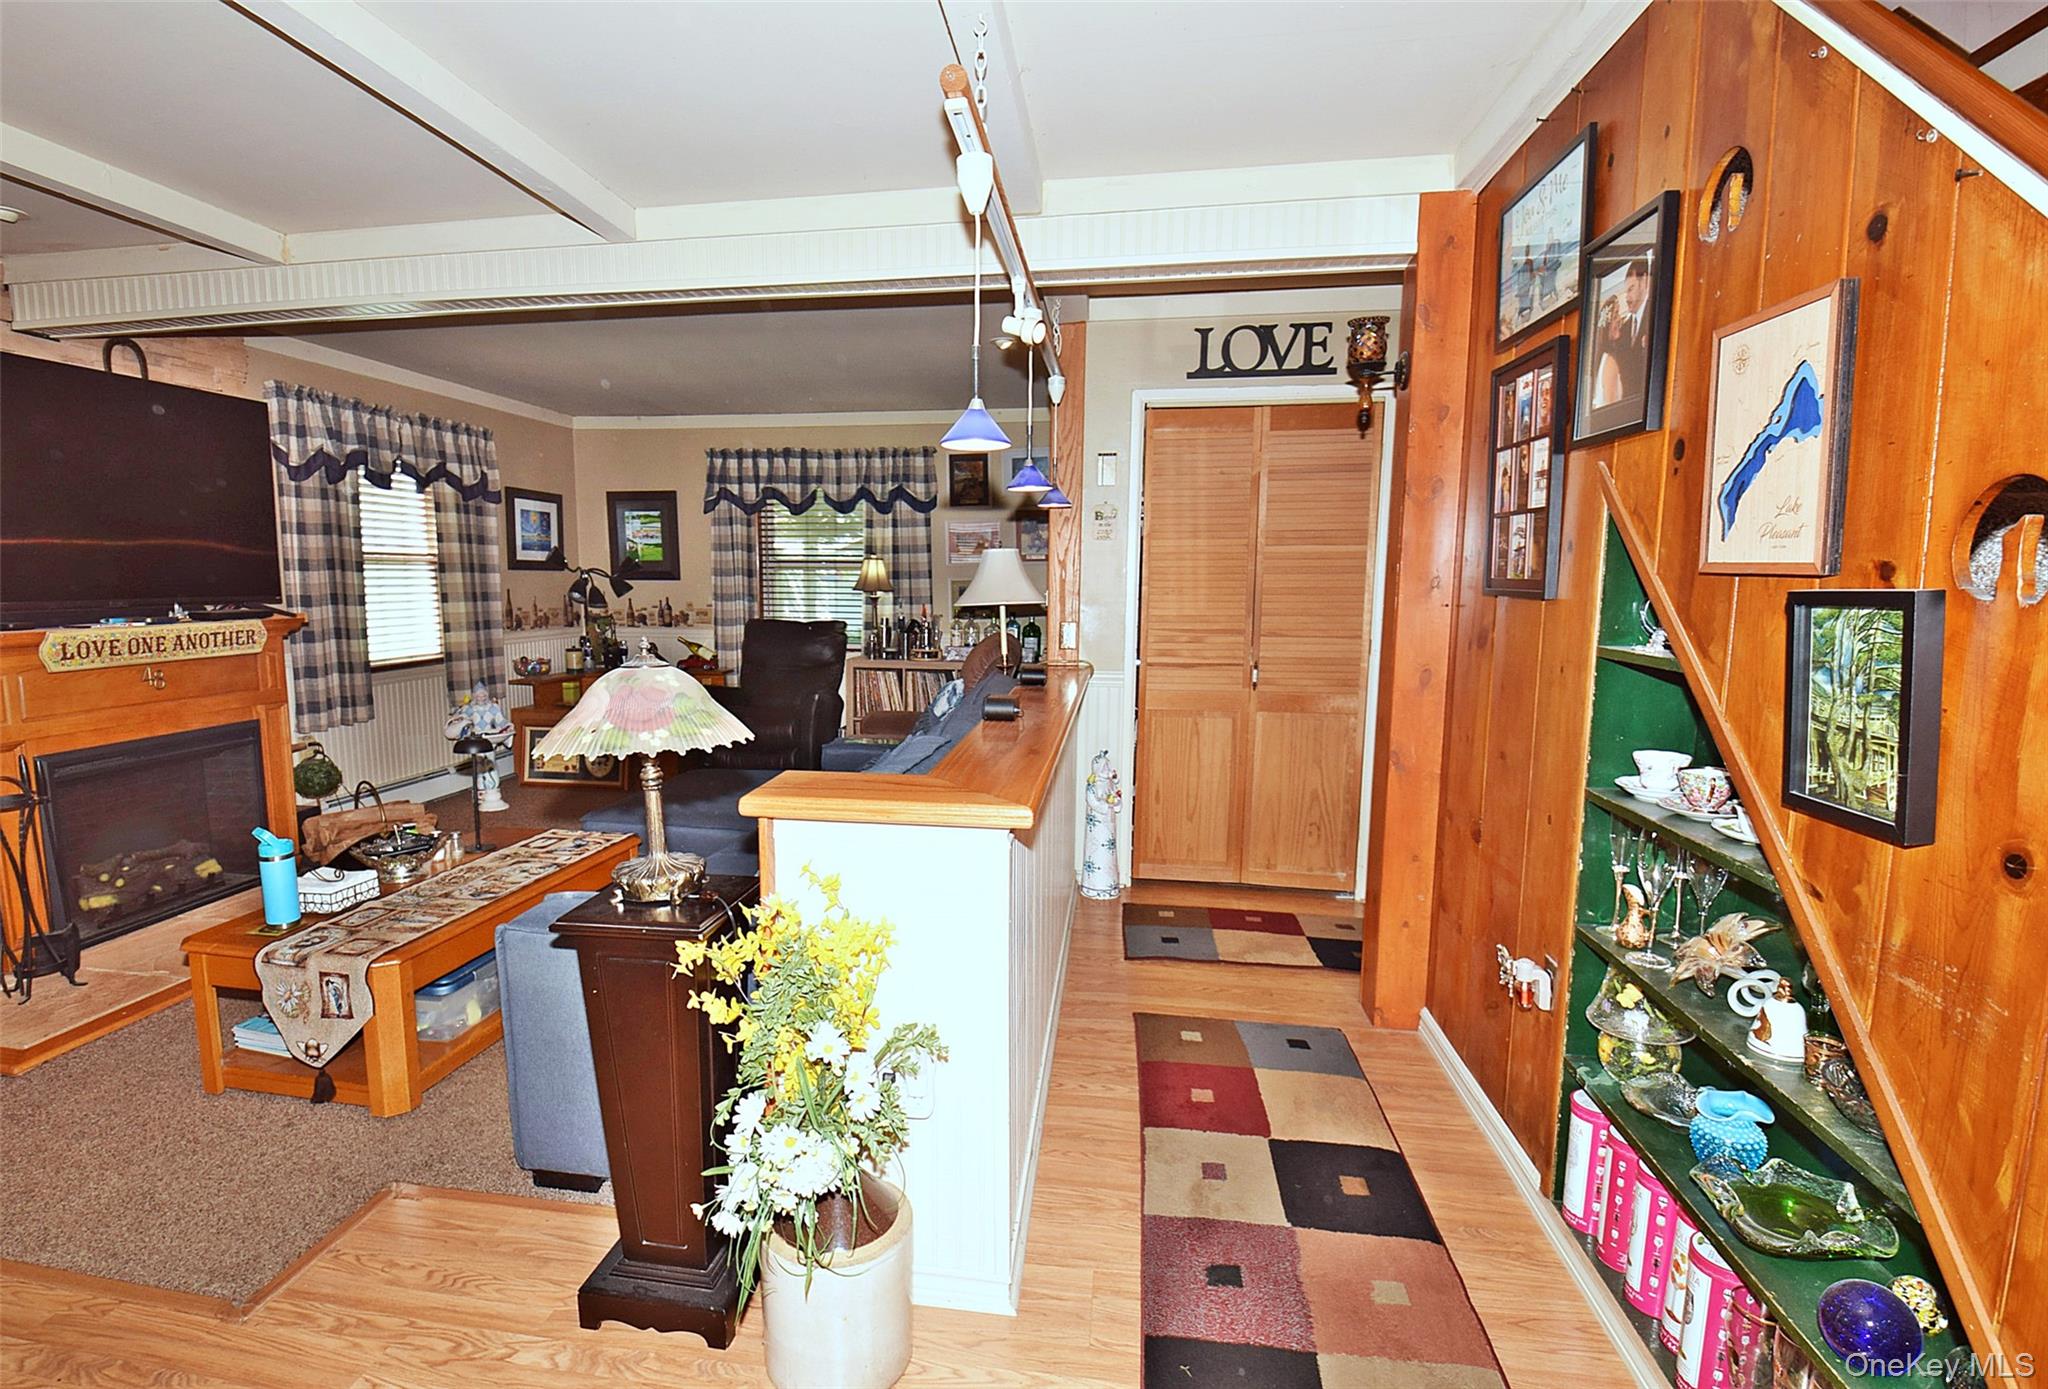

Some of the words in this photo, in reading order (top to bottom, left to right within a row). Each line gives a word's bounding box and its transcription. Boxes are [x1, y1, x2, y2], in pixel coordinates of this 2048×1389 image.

[1194, 321, 1336, 374] LOVE
[1774, 495, 1802, 519] Lake
[1759, 521, 1808, 543] Pleasant
[60, 638, 122, 661] LOVE
[127, 636, 167, 655] ONE
[172, 629, 257, 651] ANOTHER
